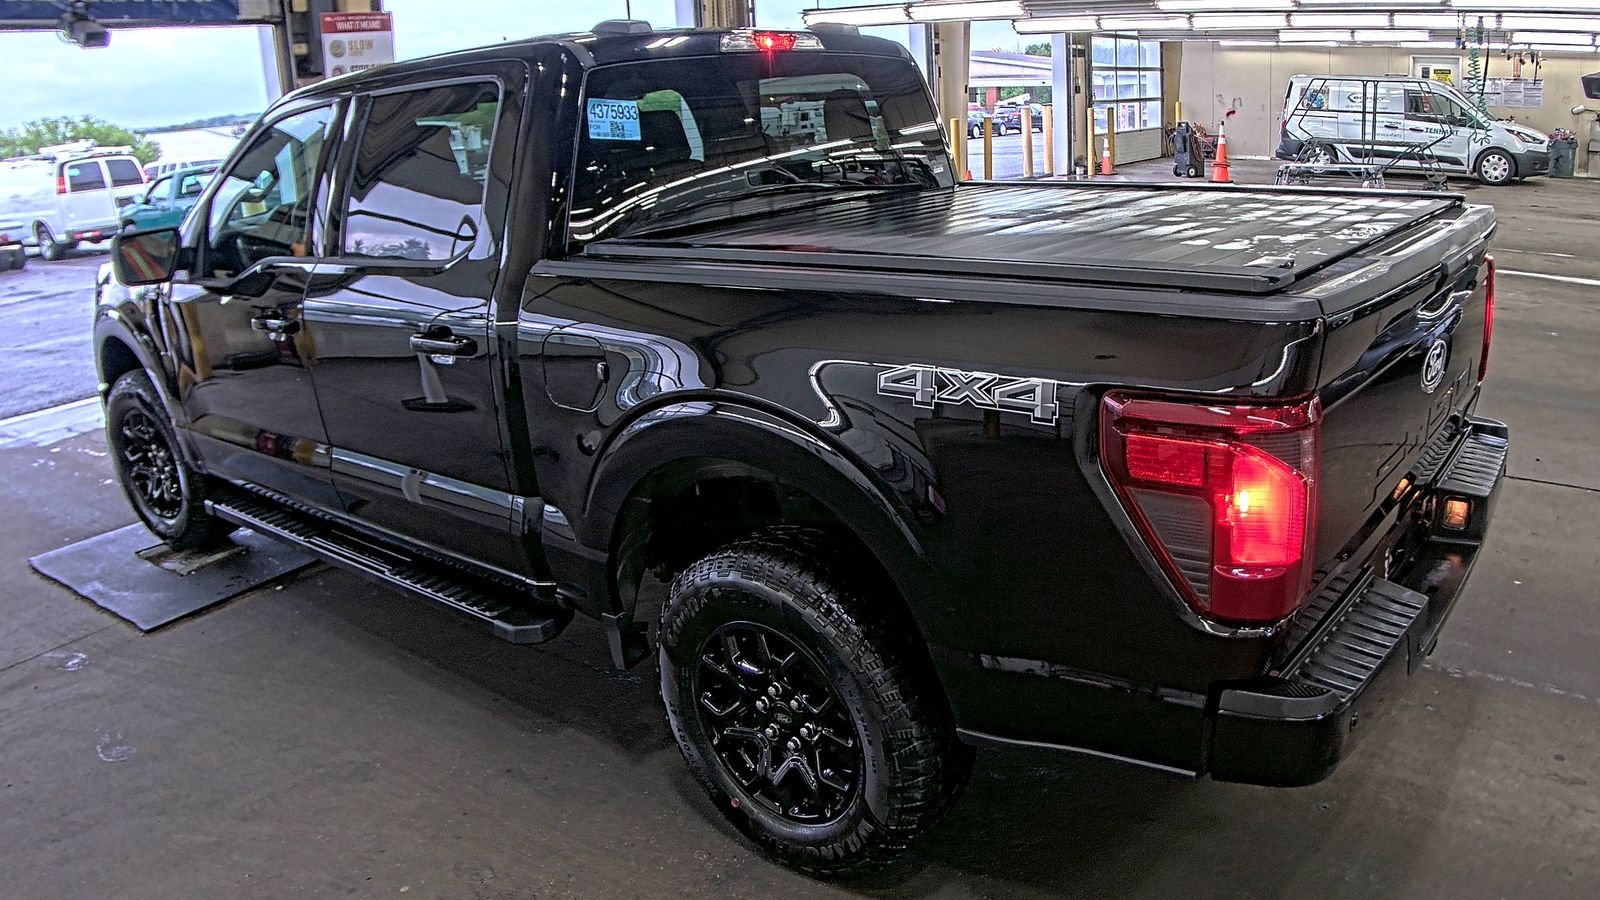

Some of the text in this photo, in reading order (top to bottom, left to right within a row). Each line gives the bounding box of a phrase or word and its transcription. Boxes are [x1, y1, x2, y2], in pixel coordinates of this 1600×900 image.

[336, 21, 353, 31] WHAT
[353, 20, 360, 30] IT
[348, 39, 373, 50] SLOW
[590, 103, 638, 120] 4375933
